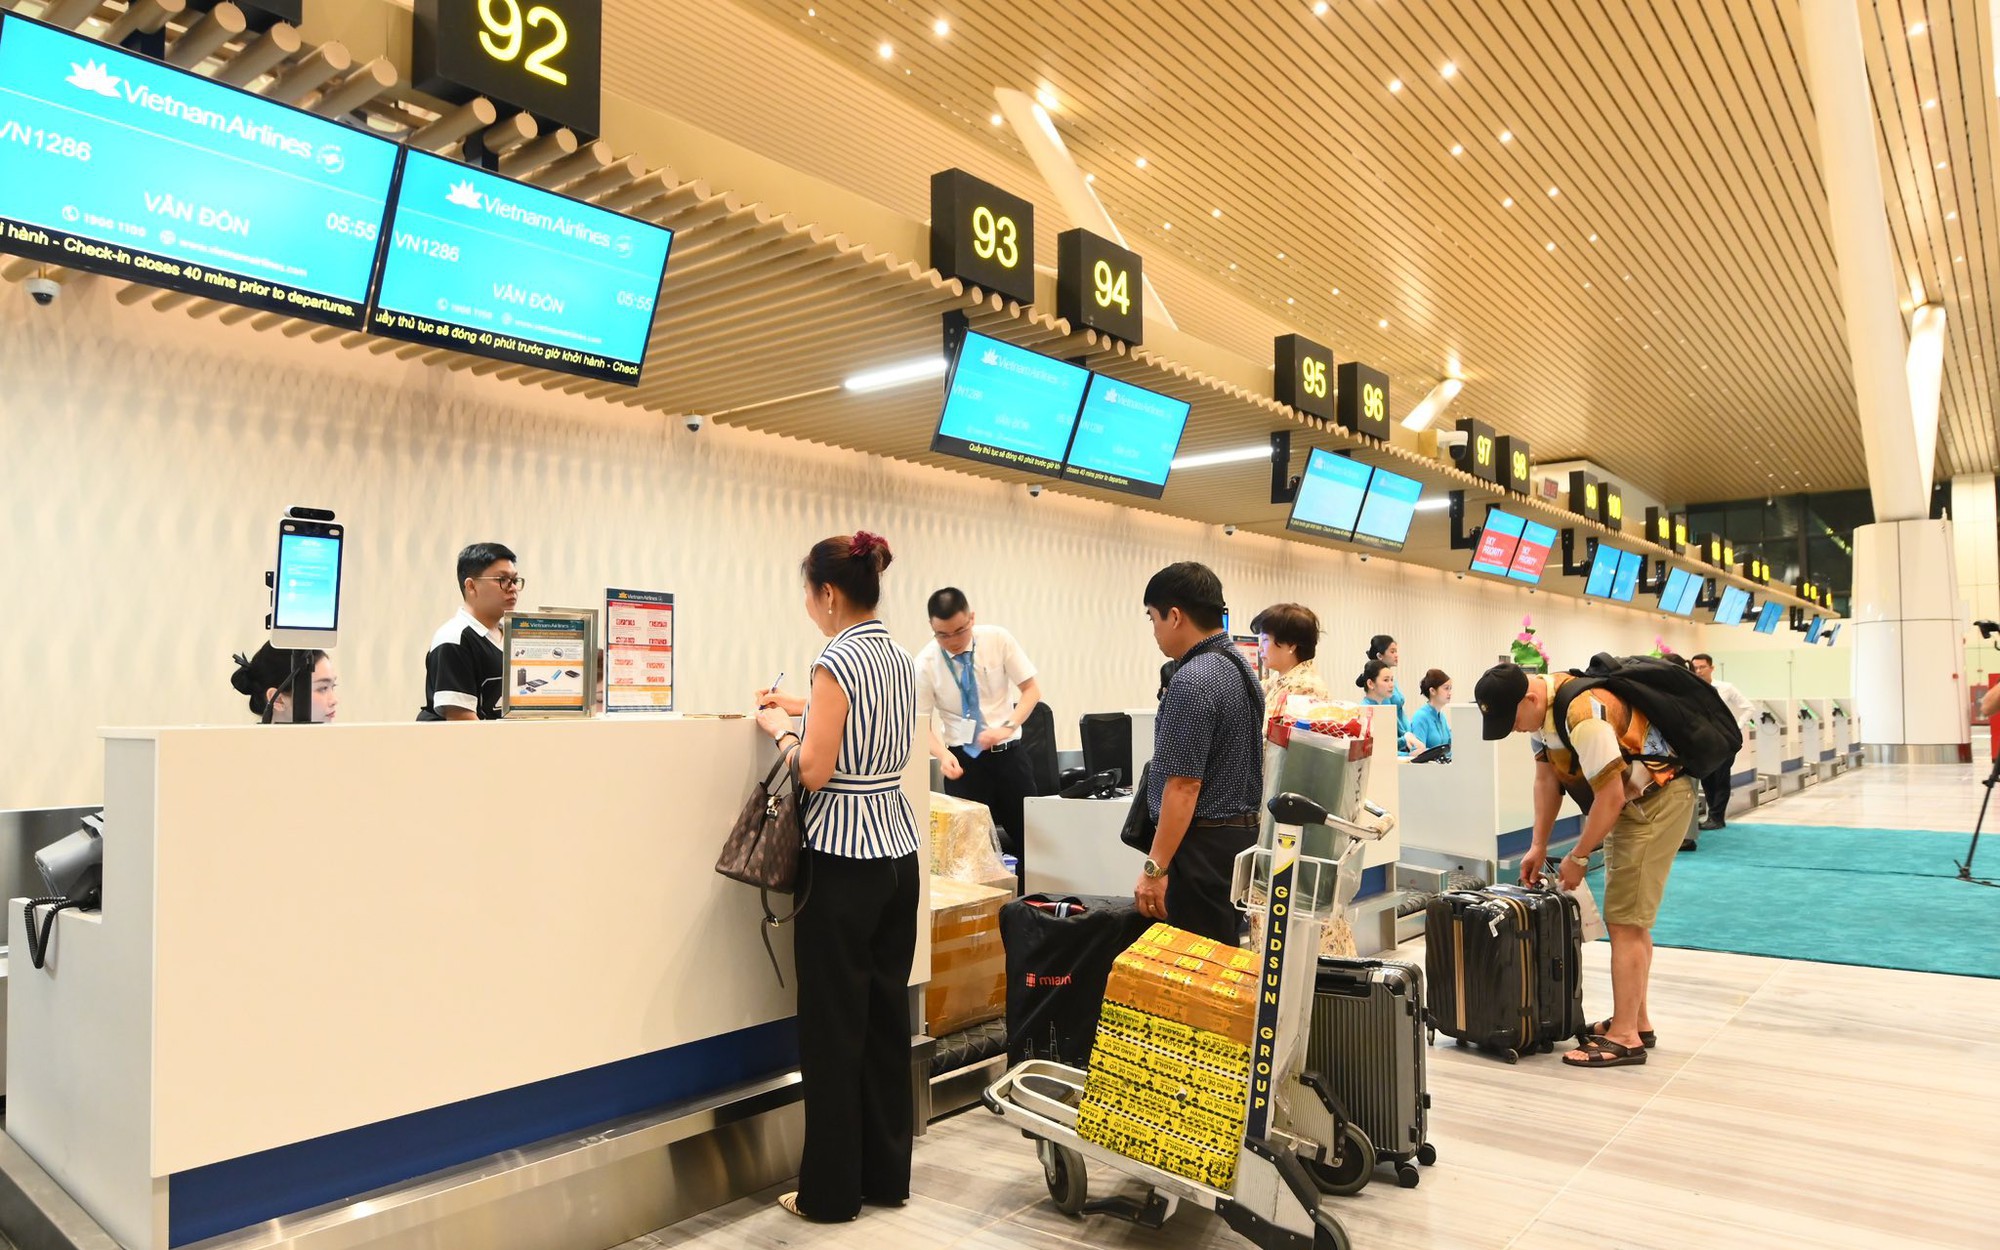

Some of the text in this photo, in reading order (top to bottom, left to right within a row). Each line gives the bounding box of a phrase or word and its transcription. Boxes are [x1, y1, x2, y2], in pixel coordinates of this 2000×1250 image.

[478, 0, 568, 86] 92
[124, 80, 312, 159] Vietnam Airlines
[326, 212, 377, 241] 05:55
[484, 194, 611, 248] Vietnam Airlines
[972, 206, 1019, 269] 93
[395, 230, 461, 262] VN1286
[8, 223, 49, 246] hành
[64, 237, 131, 265] Check-in
[134, 255, 180, 277] closes
[183, 265, 202, 281] 40
[204, 272, 237, 289] mins
[238, 280, 271, 297] prior
[271, 286, 285, 300] to
[287, 290, 355, 316] departures.
[1094, 260, 1131, 315] 94
[616, 290, 652, 310] 05:55
[417, 320, 434, 333] tục
[451, 327, 477, 344] đóng
[479, 333, 492, 345] 40
[493, 336, 516, 350] phút
[583, 355, 605, 369] hành
[613, 361, 639, 376] Check
[1302, 356, 1326, 399] 95
[1363, 383, 1384, 422] 96
[1477, 434, 1492, 466] 97
[1513, 450, 1527, 481] 98
[1264, 886, 1289, 1005] GOLDSUN
[1156, 1024, 1186, 1038] FRAGILE
[1152, 1059, 1182, 1073] FRAGILE
[1254, 1026, 1274, 1109] GROUP
[1158, 1082, 1179, 1094] AGILE
[1162, 1140, 1193, 1156] FRAGILE
[1177, 1123, 1207, 1138] FRAGILE
